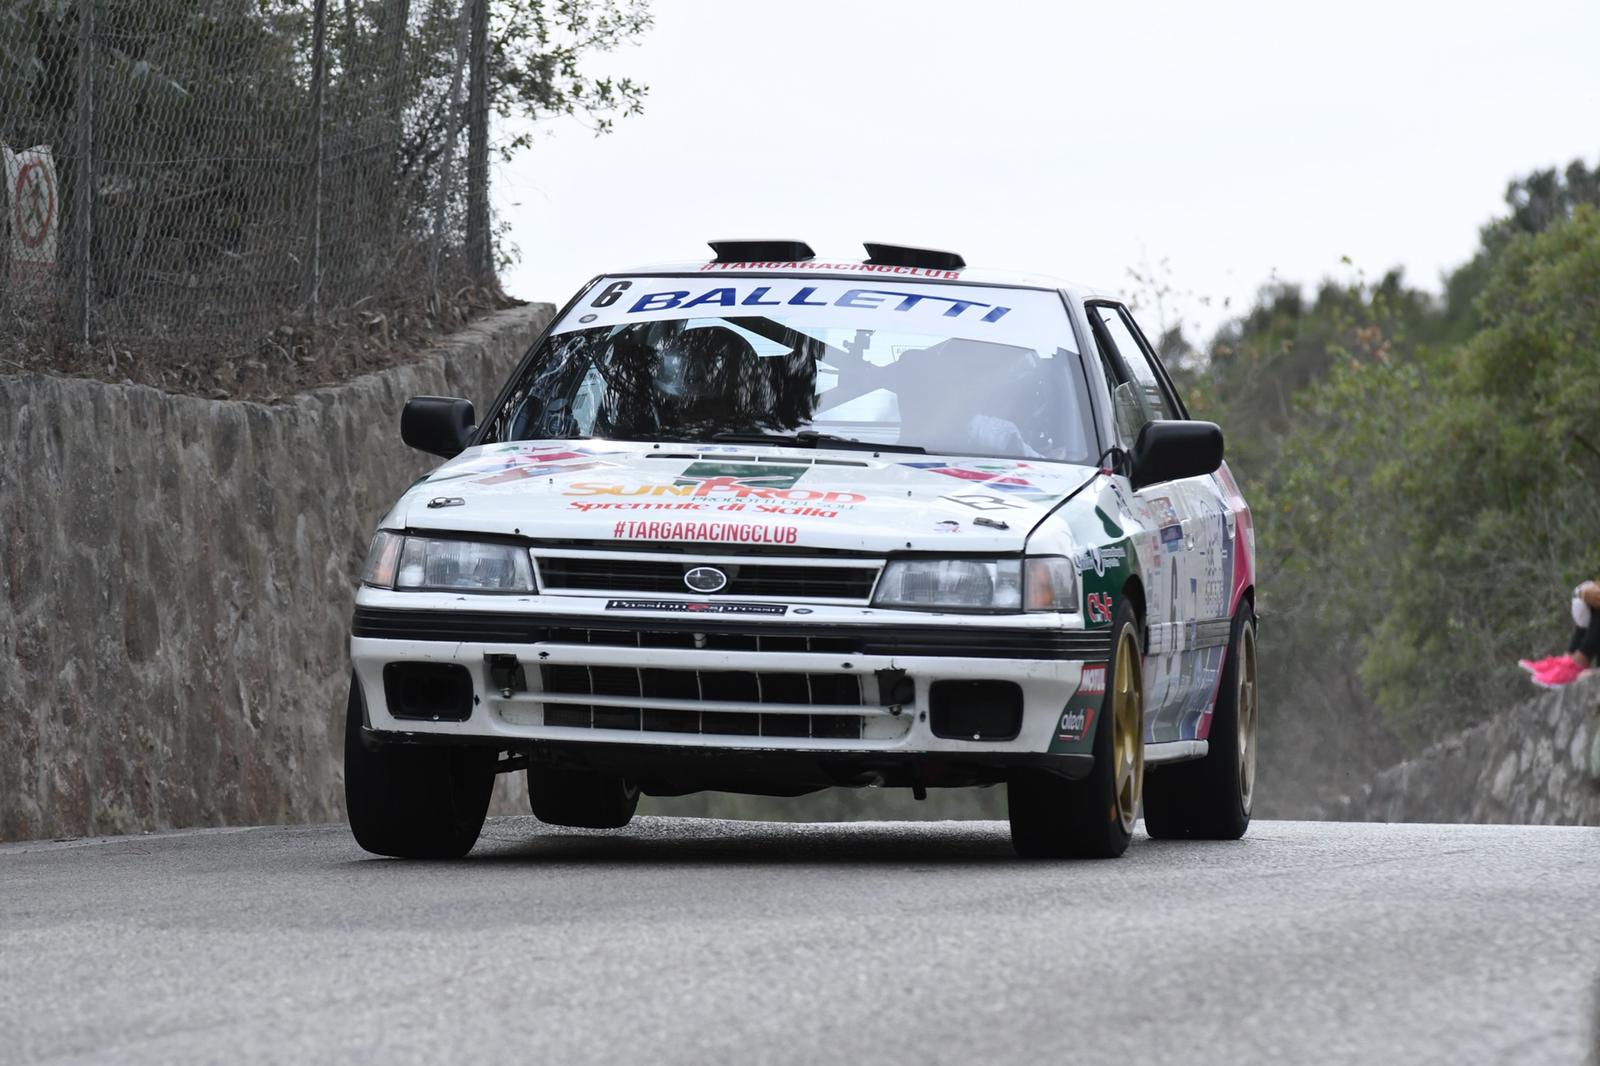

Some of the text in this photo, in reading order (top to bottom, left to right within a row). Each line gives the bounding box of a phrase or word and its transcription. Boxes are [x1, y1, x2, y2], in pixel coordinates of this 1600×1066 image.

[590, 281, 633, 308] 6
[626, 286, 1012, 324] BALLETTI
[566, 500, 839, 519] Spremute di Sicilia
[613, 520, 798, 545] #TARGARACINGCLUB
